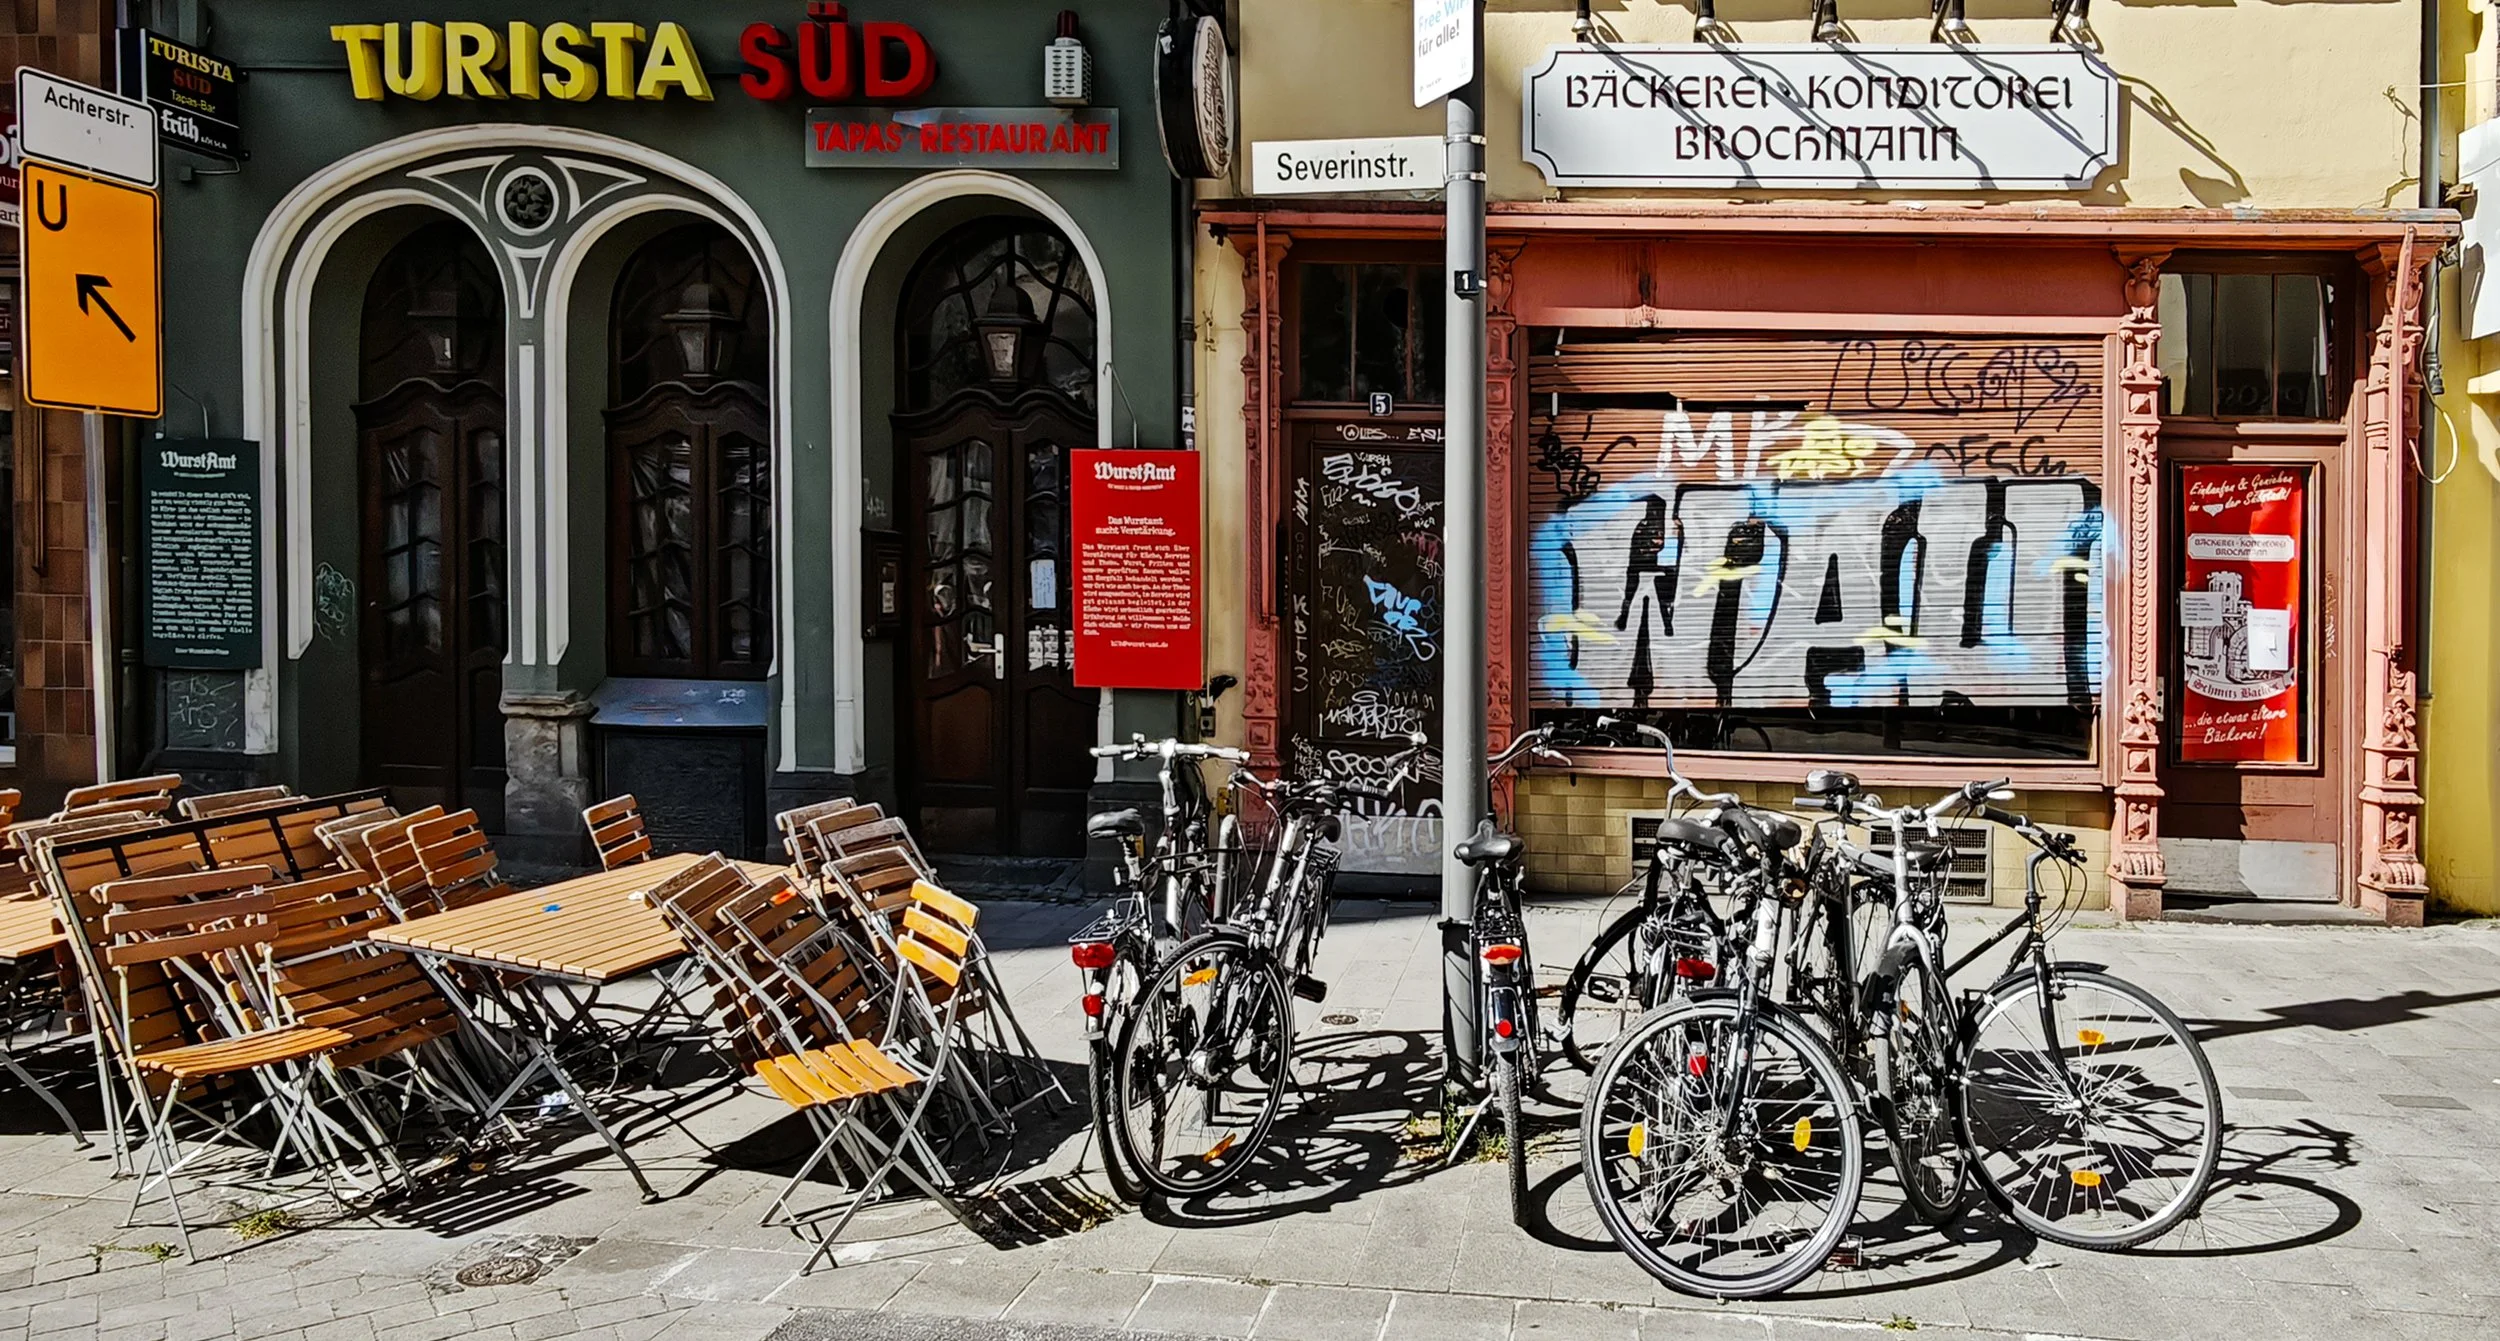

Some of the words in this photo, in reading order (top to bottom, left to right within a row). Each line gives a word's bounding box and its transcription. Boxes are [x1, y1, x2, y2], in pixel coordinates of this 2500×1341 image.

[330, 20, 714, 101] TURISTA
[738, 1, 937, 101] SÜD
[1418, 38, 1433, 57] für
[1436, 19, 1460, 48] alle!
[149, 36, 234, 83] TURISTA
[1565, 69, 1767, 110] BÄCKEREI
[1807, 73, 2072, 111] KONDITOREI
[44, 85, 136, 130] Achterstr.
[813, 122, 903, 153] TAPAS
[919, 122, 1112, 155] RESTAURANT
[1674, 122, 1961, 162] BROCHMANN
[1276, 150, 1414, 182] Severinstr.
[36, 178, 68, 232] U
[1461, 272, 1469, 290] 1
[1375, 395, 1387, 414] 5
[160, 451, 237, 472] WurstAmt
[1093, 461, 1177, 483] WurstAmt
[2237, 477, 2249, 491] &
[2188, 501, 2200, 512] in
[2224, 496, 2242, 509] der
[1095, 526, 1119, 535] sucht
[1120, 525, 1176, 537] Verstärkung.
[1107, 515, 1123, 525] Das
[1124, 515, 1164, 525] Wurstamt
[2193, 679, 2237, 698] Schmitz
